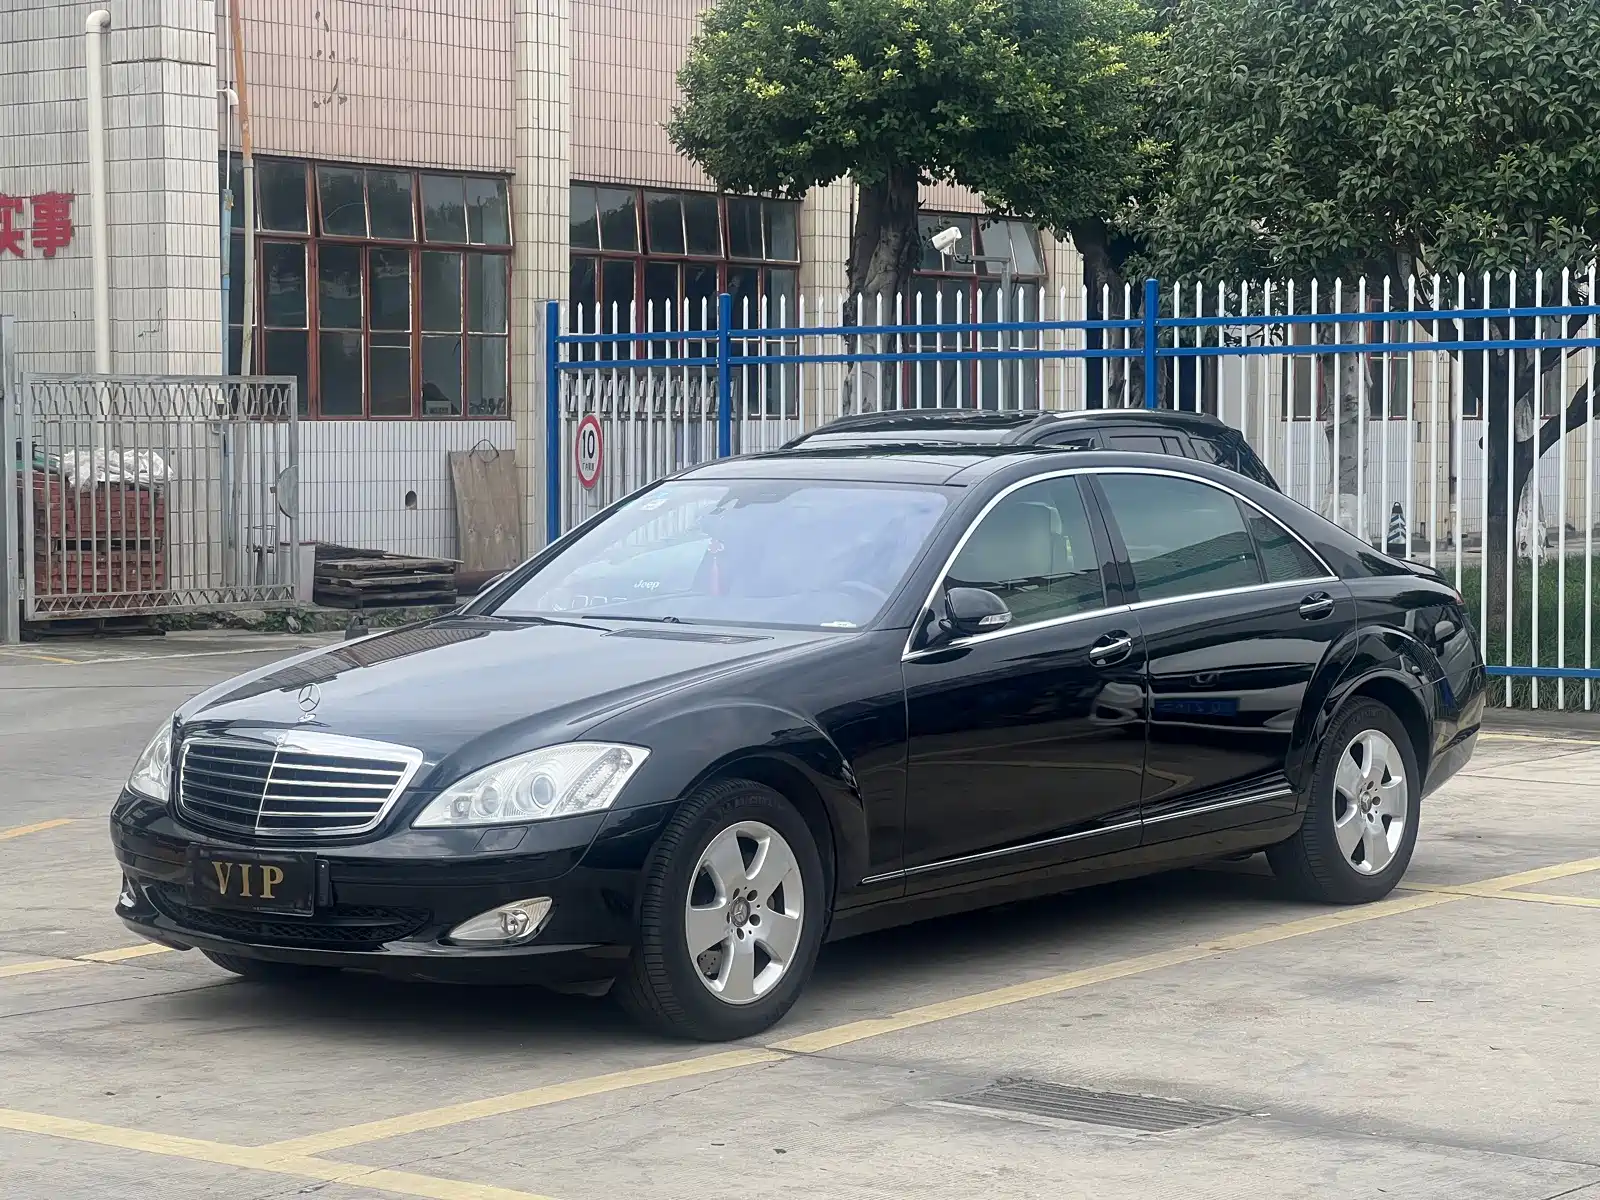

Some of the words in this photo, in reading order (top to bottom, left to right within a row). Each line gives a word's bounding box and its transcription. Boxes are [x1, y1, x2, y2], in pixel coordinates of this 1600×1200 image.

[582, 429, 595, 459] 10
[634, 579, 660, 590] Jeep
[211, 861, 284, 899] VIP
